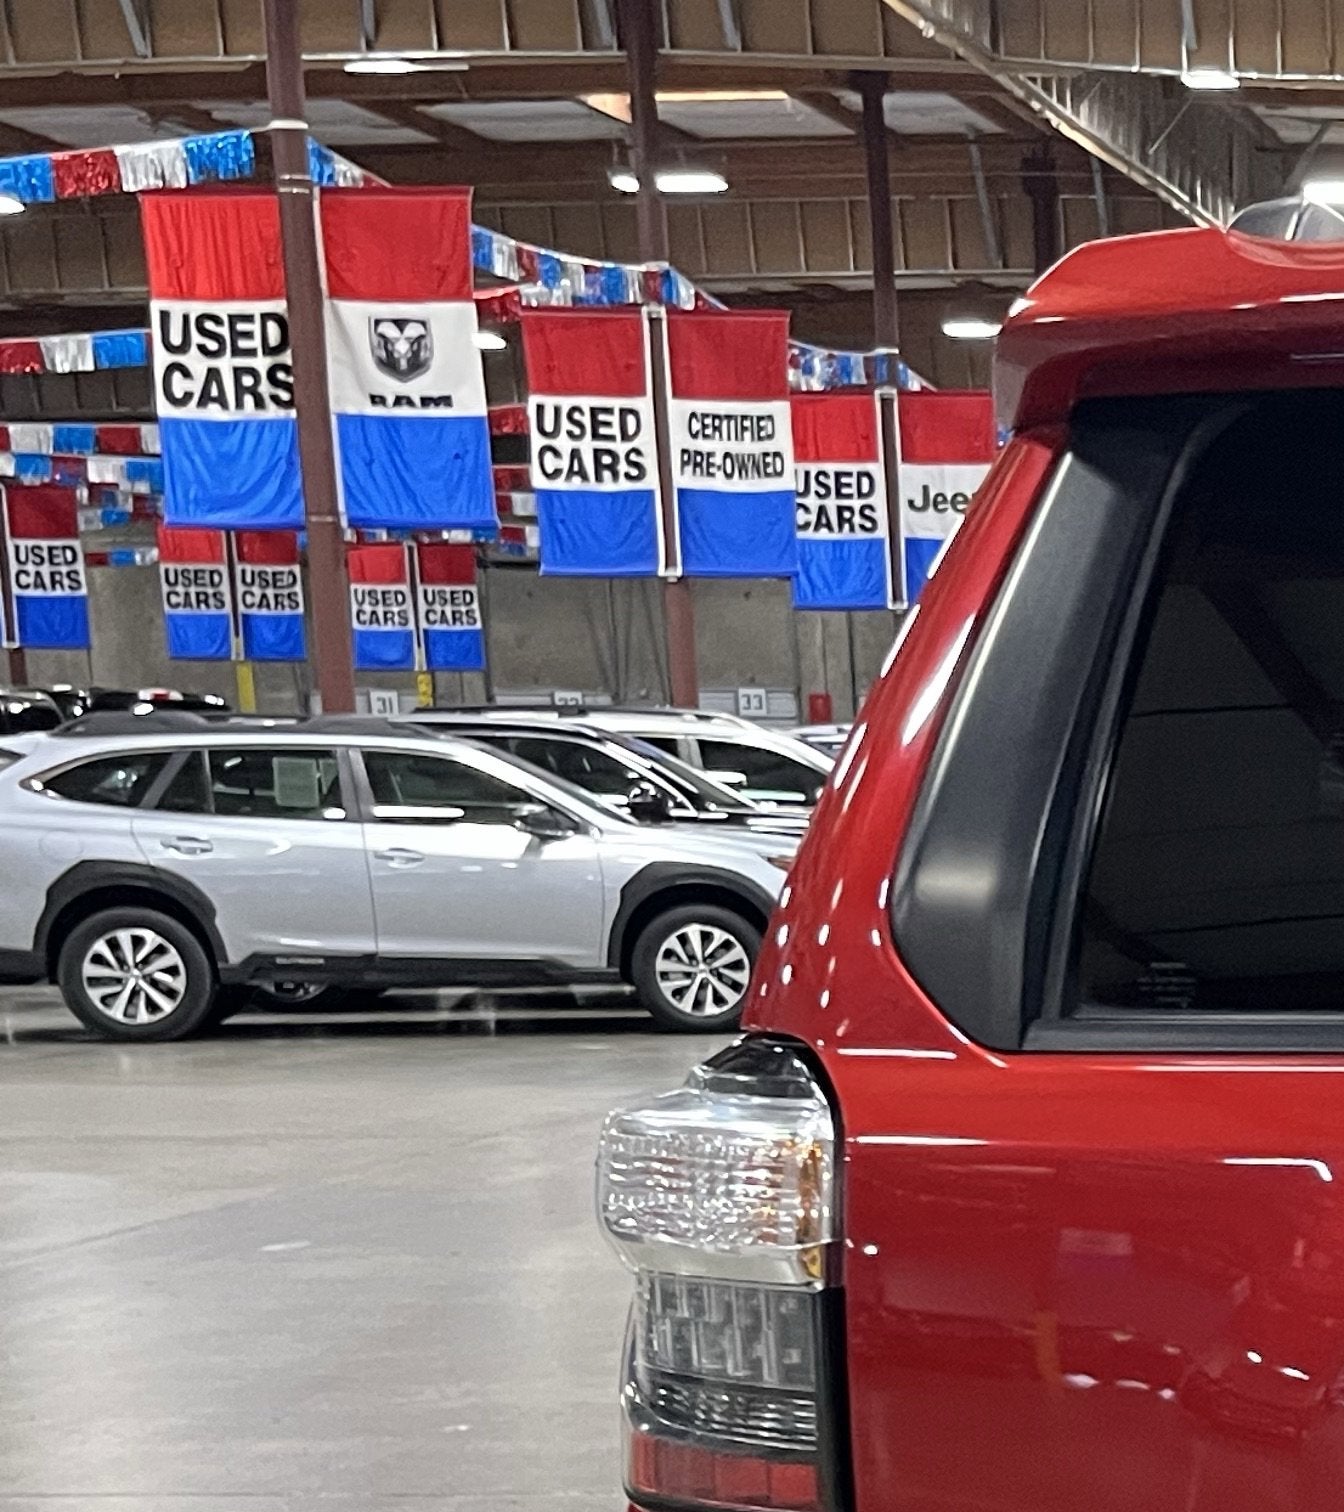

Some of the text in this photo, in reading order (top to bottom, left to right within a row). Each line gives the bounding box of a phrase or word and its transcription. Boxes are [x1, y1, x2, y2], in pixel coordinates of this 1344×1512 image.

[159, 310, 289, 359] USED
[162, 361, 294, 411] CARS
[369, 393, 453, 408] RAM
[536, 403, 641, 443] USED
[687, 411, 776, 442] CERTIFIED
[538, 444, 647, 484] CARS
[680, 448, 785, 480] PRE-OWNED
[795, 469, 875, 500] USED
[907, 484, 975, 514] Jee
[795, 503, 878, 534] CARS
[15, 545, 77, 567] USED
[15, 569, 83, 592] CARS
[164, 568, 223, 588] USED
[241, 568, 297, 588] USED
[166, 591, 226, 610] CARS
[241, 591, 300, 611] CARS
[353, 588, 407, 607] USED
[423, 588, 475, 607] USED
[356, 608, 410, 627] CARS
[424, 608, 478, 626] CARS
[741, 693, 764, 711] 33
